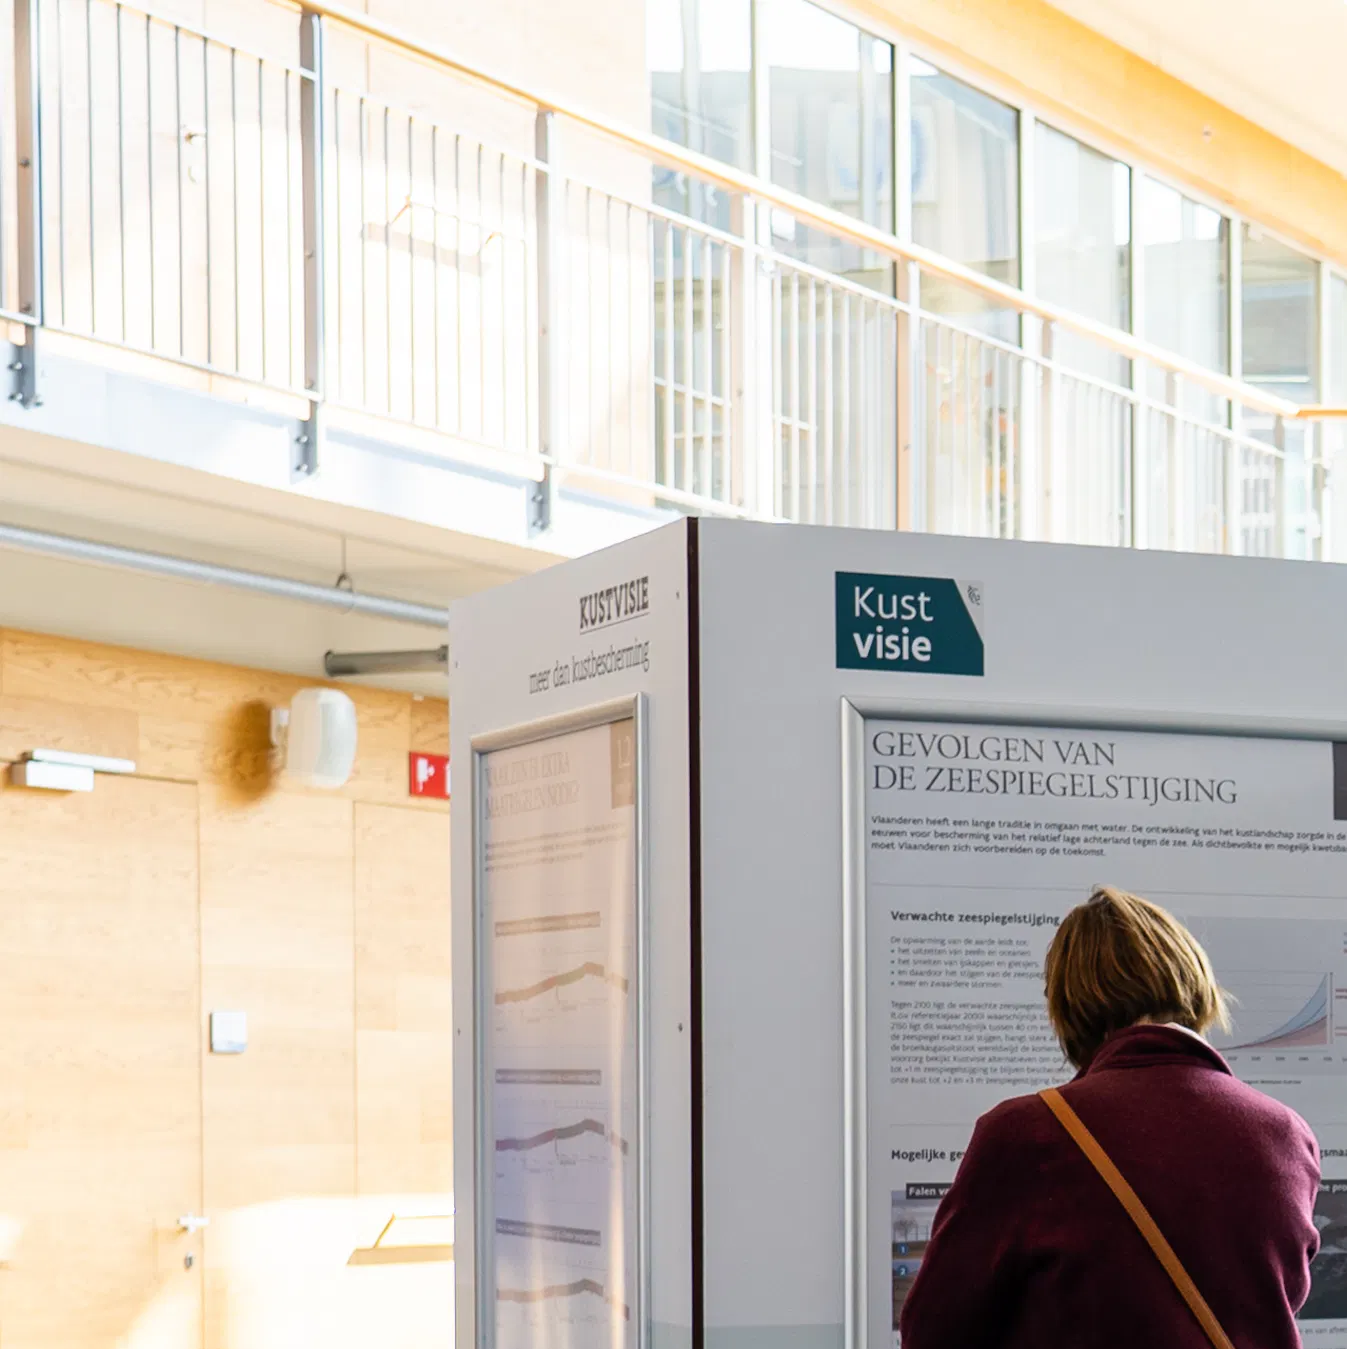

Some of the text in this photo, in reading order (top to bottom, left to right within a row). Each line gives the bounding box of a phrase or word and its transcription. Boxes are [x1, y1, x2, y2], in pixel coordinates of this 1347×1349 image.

[579, 576, 649, 629] KUSTVISIE
[854, 585, 934, 622] Kust
[852, 625, 932, 662] visie
[529, 637, 650, 694] meer dan kustbescherming
[872, 731, 1116, 767] GEVOLGEN VAN
[872, 765, 1238, 806] DE ZEESPIEGELSTIJGING
[871, 815, 924, 825] Vlaanderen
[926, 817, 949, 826] heeft
[971, 818, 995, 829] lange
[998, 819, 1031, 829] traditie
[1034, 820, 1042, 829] in
[1045, 822, 1079, 832] omgaan
[1082, 822, 1099, 831] met
[1101, 823, 1129, 832] water.
[1132, 825, 1143, 833] De
[1146, 825, 1200, 836] ontwikkeling
[1219, 828, 1234, 836] het
[1236, 829, 1294, 840] kustlandschap
[1297, 831, 1324, 841] zorgde
[1326, 832, 1334, 840] in
[1336, 832, 1346, 841] de
[871, 830, 907, 838] eeuwen
[934, 830, 990, 843] bescherming
[993, 833, 1009, 841] van
[1011, 832, 1026, 841] het
[1029, 833, 1061, 842] relatief
[1063, 834, 1081, 845] lage
[1083, 835, 1130, 845] achterland
[1133, 839, 1157, 849] tegen
[1160, 838, 1170, 846] de
[1191, 839, 1203, 848] Als
[1206, 839, 1262, 850] dichtbevolkte
[1277, 842, 1310, 853] mogelijk
[871, 841, 1106, 857] moet Vlaanderen zich voorbereiden op de toekomst.
[891, 911, 1061, 926] Verwachte zeespiegelstijging
[891, 1149, 946, 1163] Mogelijke
[908, 1186, 936, 1196] Falen
